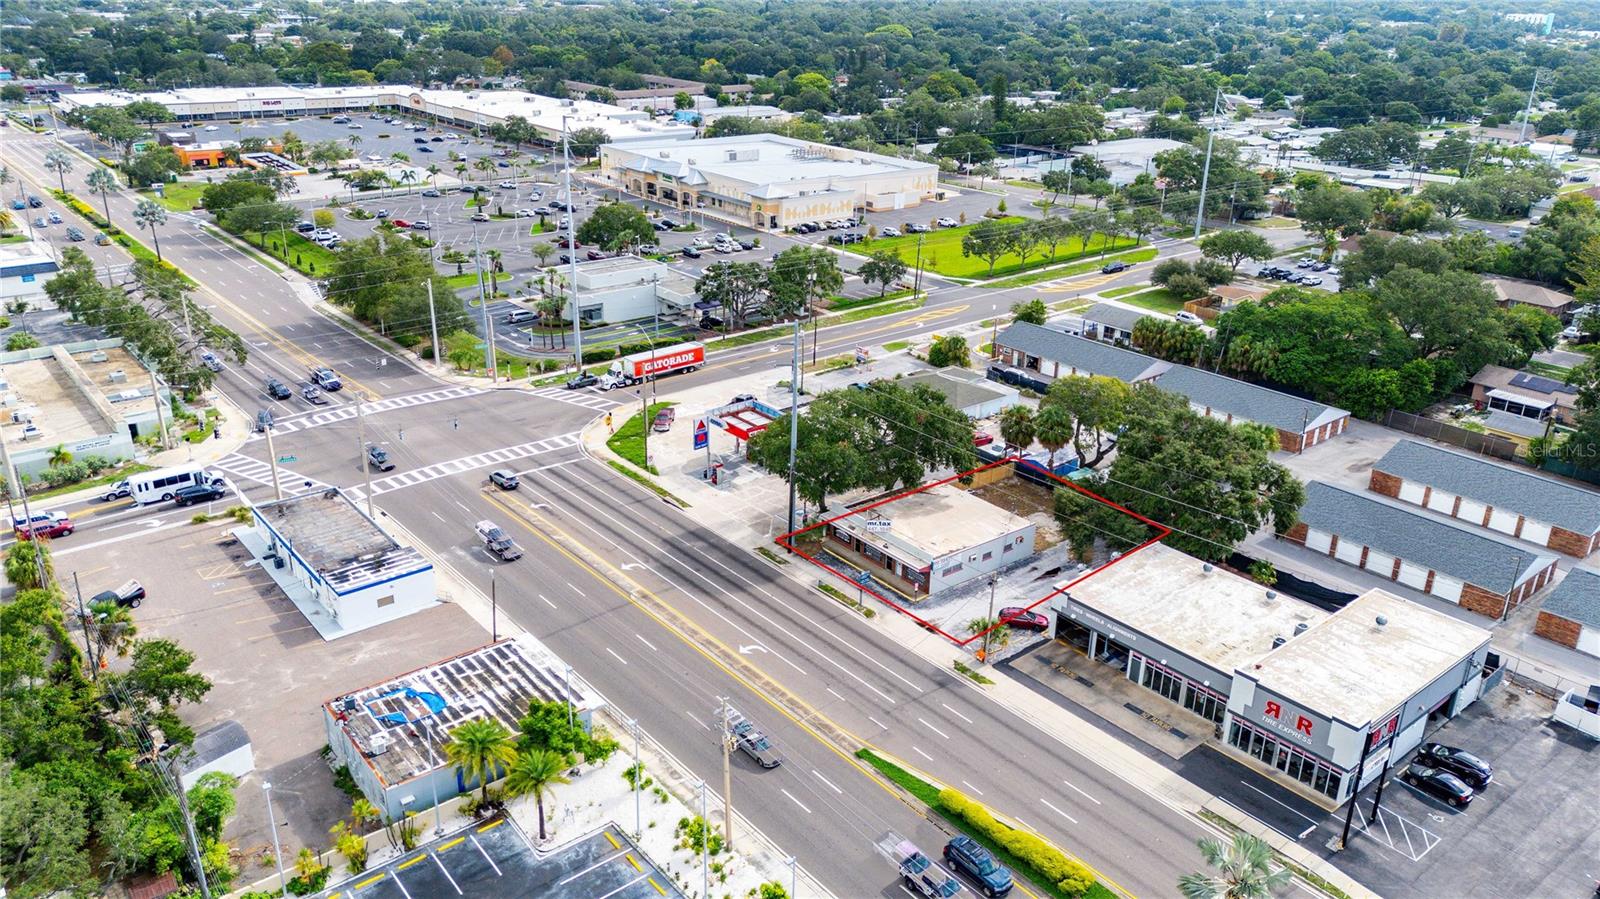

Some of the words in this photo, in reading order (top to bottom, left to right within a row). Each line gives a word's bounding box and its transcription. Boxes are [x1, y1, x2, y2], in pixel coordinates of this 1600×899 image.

[644, 353, 694, 371] GATORADE
[1262, 715, 1278, 728] TIRE
[1278, 724, 1313, 745] EXPRESS
[1264, 701, 1313, 736] RNR
